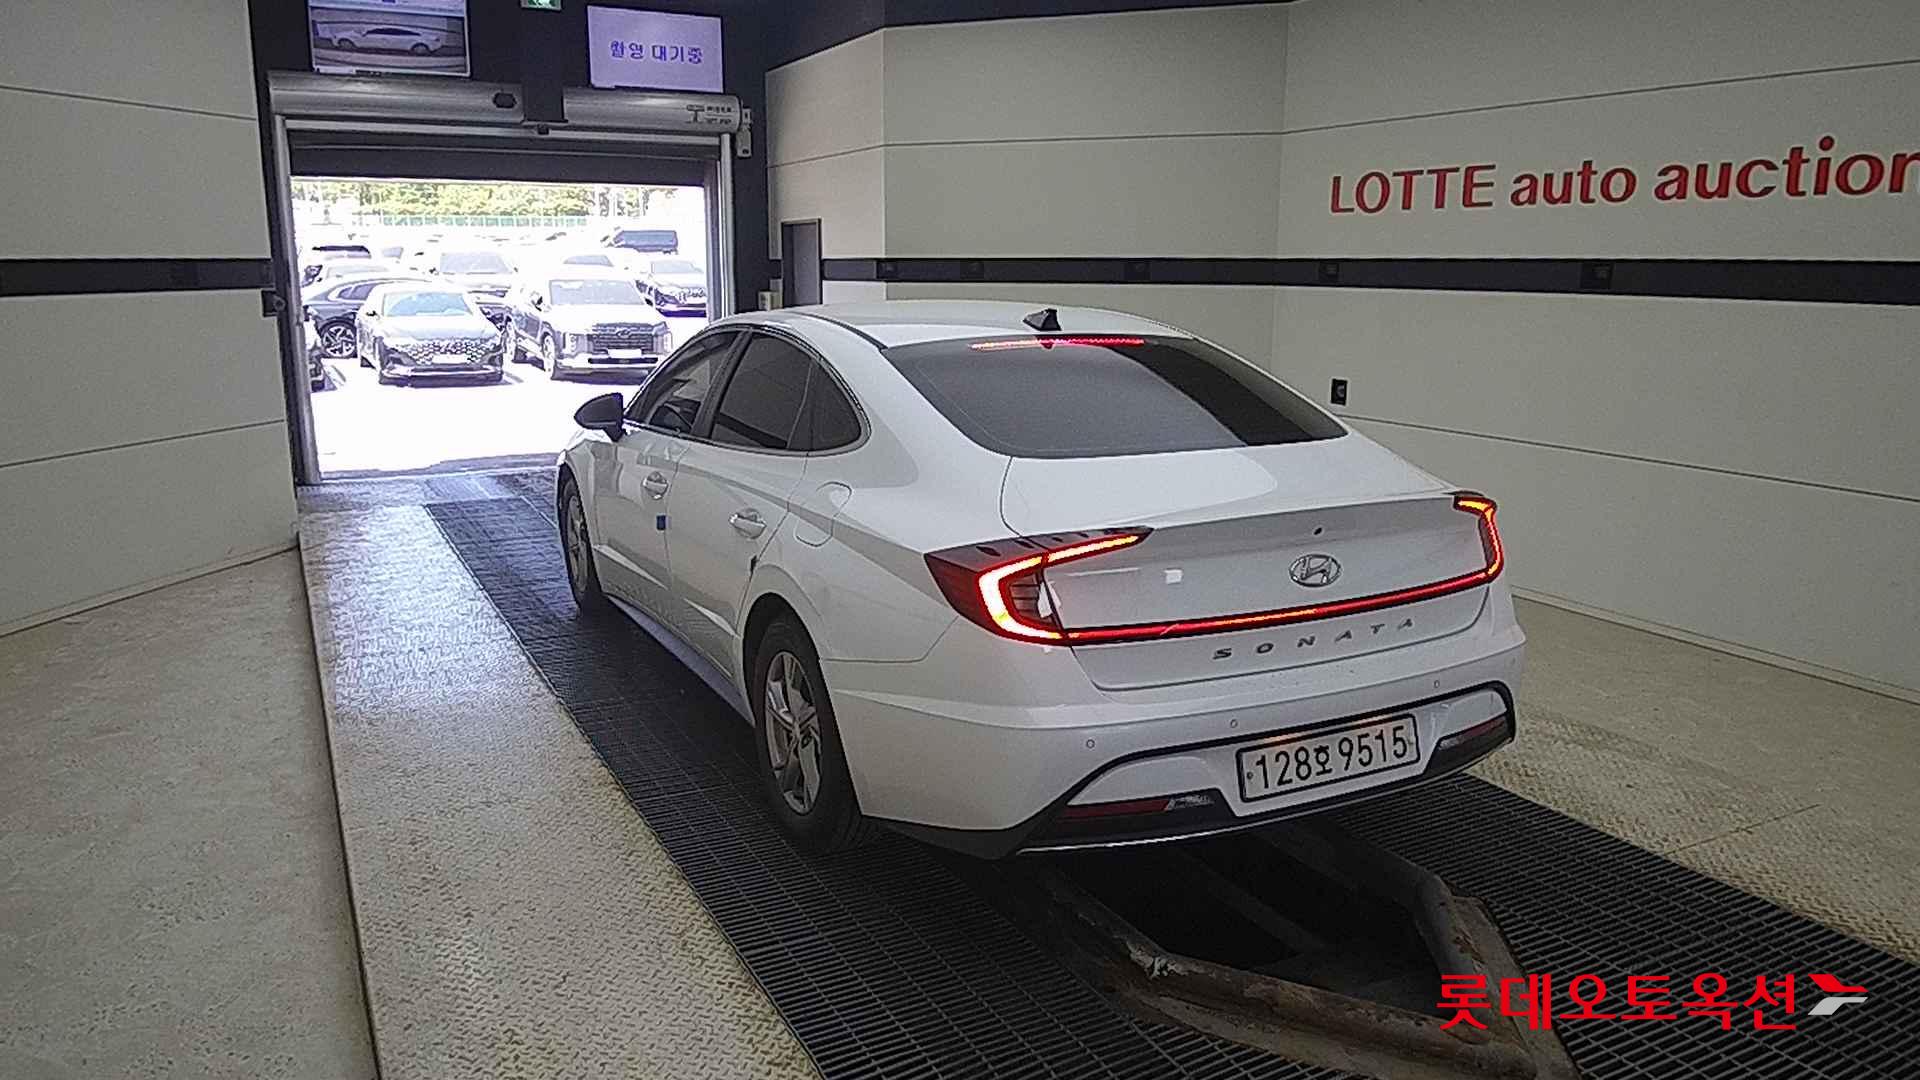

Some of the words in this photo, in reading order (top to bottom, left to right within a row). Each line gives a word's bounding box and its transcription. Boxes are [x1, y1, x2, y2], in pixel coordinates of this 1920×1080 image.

[651, 44, 702, 64] 대기중
[1330, 164, 1496, 214] LOTTE
[1510, 159, 1637, 206] auto
[1212, 618, 1413, 660] SONATA
